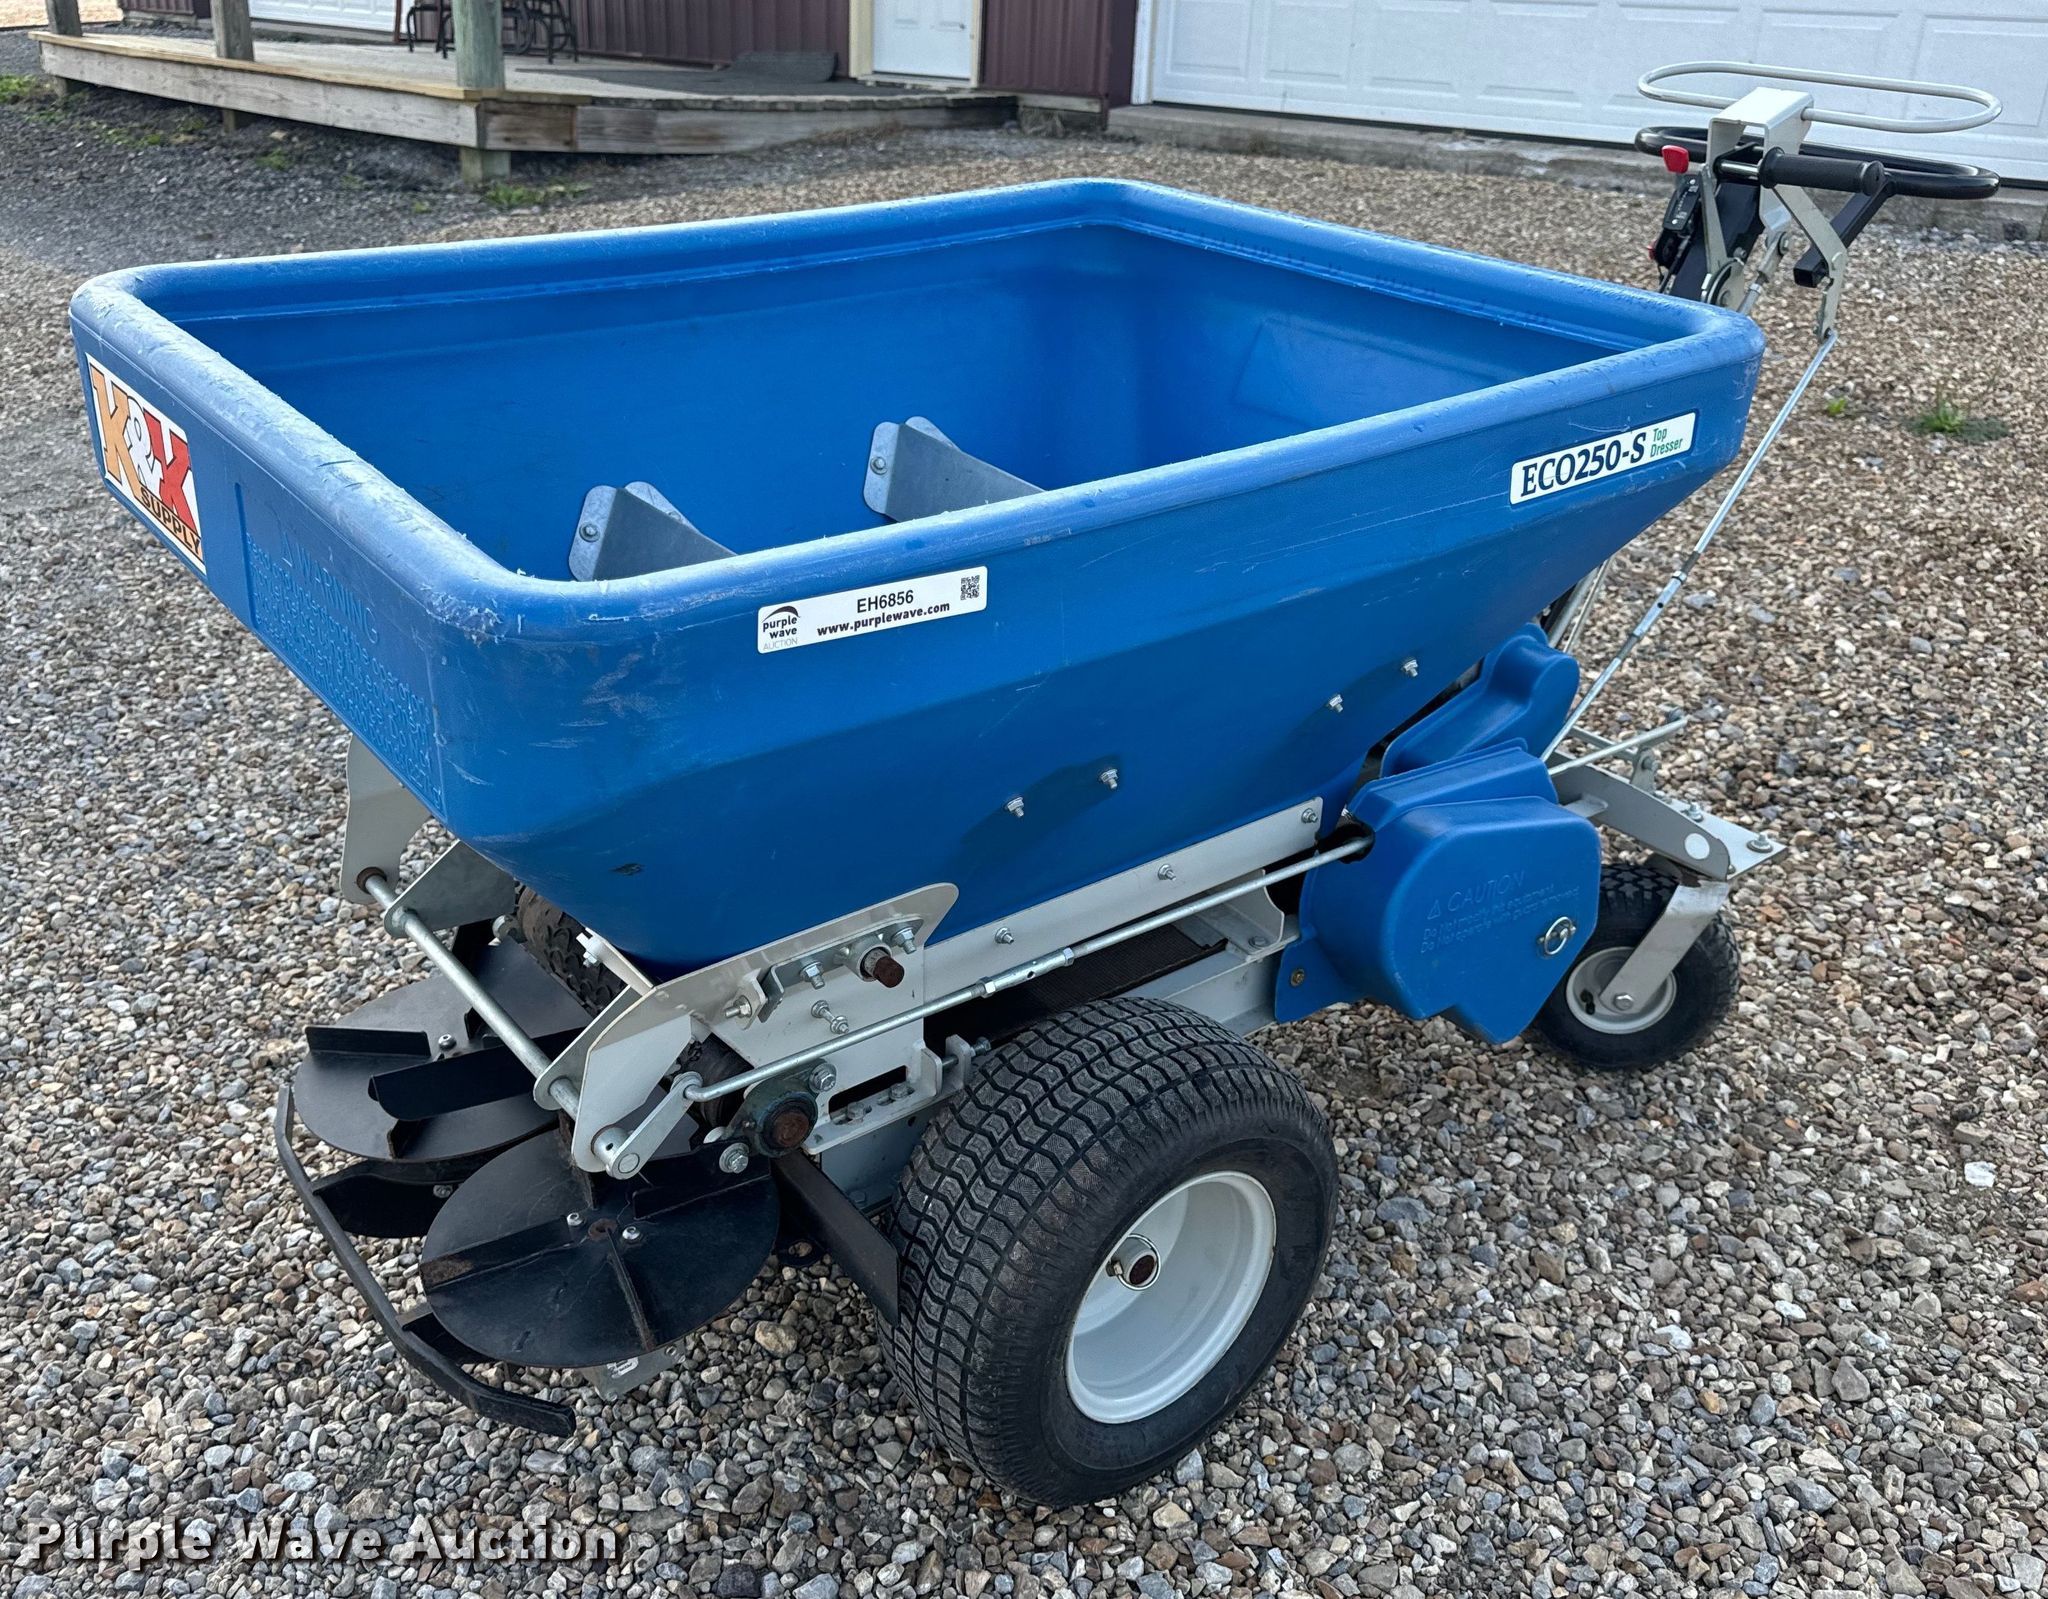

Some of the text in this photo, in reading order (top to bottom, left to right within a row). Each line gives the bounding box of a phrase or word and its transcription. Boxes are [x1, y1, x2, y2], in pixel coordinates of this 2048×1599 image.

[90, 363, 199, 534] K&K
[1650, 437, 1683, 457] Dresser
[1653, 428, 1667, 442] Top
[1520, 432, 1646, 497] ECO250-S
[140, 486, 201, 554] SUPPLY
[295, 541, 380, 650] WARNING
[857, 590, 914, 614] EH6856
[763, 616, 798, 633] purple
[769, 627, 797, 639] wave
[817, 602, 950, 636] www.purplewave.com
[763, 637, 798, 651] AUCTION
[1447, 871, 1525, 911] CAUTION
